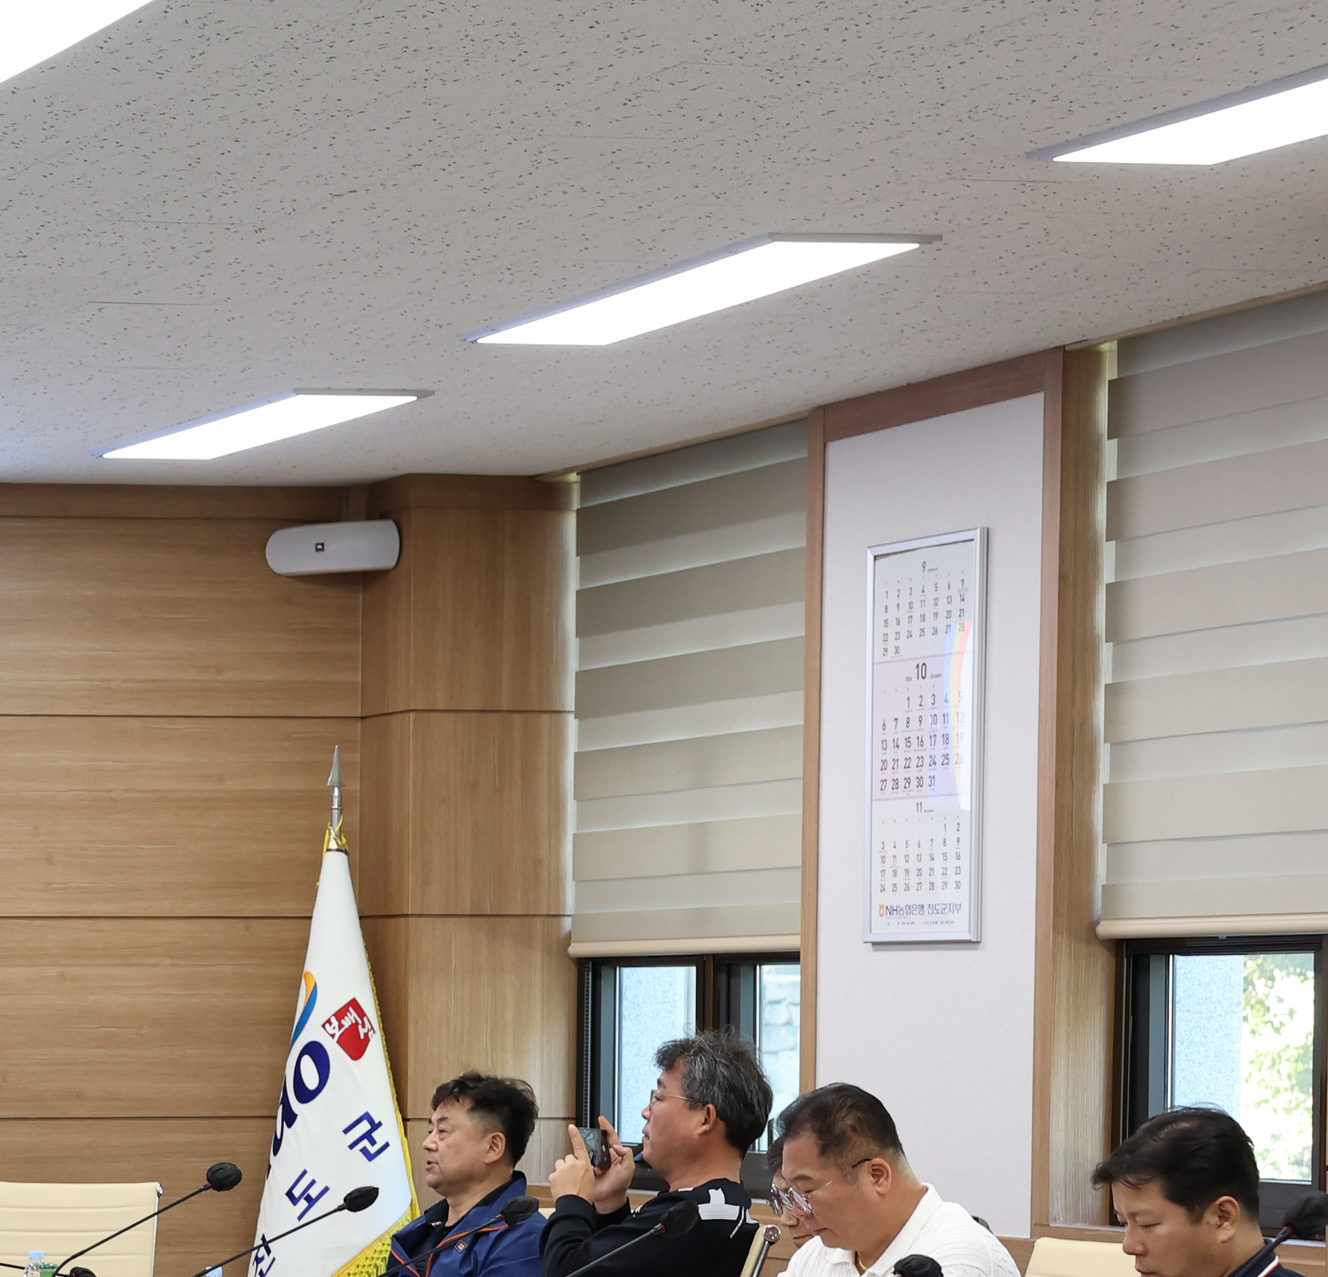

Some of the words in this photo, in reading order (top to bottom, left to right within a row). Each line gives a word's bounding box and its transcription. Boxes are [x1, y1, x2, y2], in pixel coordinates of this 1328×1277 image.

[915, 662, 927, 680] 10
[907, 696, 910, 708] 1
[919, 695, 923, 707] 2
[931, 693, 936, 706] 3
[943, 692, 948, 704] 4
[882, 719, 886, 731] 6
[894, 718, 898, 729] 7
[906, 716, 910, 729] 8
[918, 715, 923, 727] 9
[930, 713, 938, 726] 10
[942, 712, 949, 725] 11
[881, 739, 888, 751] 13
[892, 738, 900, 749] 14
[904, 736, 911, 749] 15
[916, 736, 924, 748] 16
[929, 734, 937, 746] 17
[942, 733, 950, 745] 18
[880, 759, 888, 771] 20
[891, 758, 899, 770] 21
[903, 757, 912, 769] 22
[916, 755, 924, 768] 23
[928, 755, 937, 767] 24
[941, 753, 950, 766] 25
[880, 778, 887, 791] 27
[891, 778, 899, 790] 28
[903, 777, 911, 789] 29
[916, 776, 924, 788] 30
[928, 775, 935, 787] 31
[916, 802, 923, 814] 11
[927, 902, 962, 915] 진도군지부
